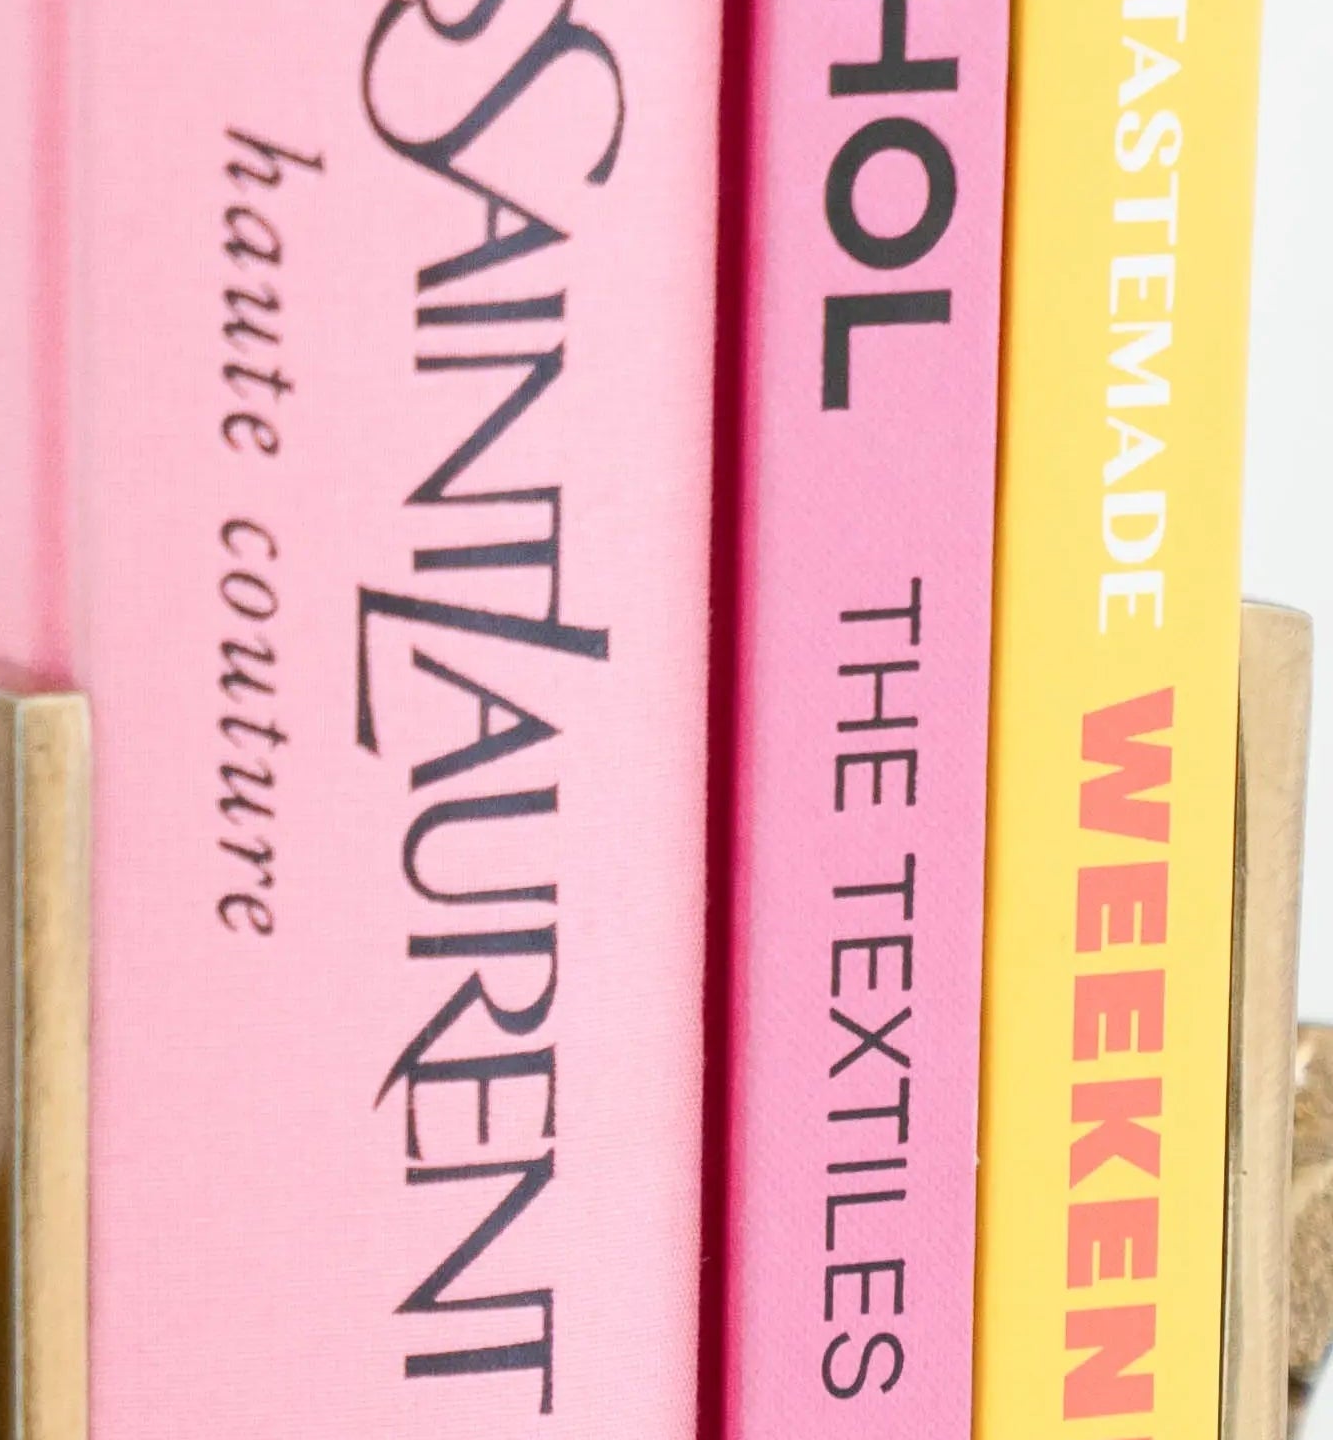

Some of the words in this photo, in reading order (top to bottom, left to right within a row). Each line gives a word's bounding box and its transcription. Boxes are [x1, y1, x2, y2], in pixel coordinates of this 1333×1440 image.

[221, 128, 323, 456] haute
[216, 518, 289, 936] couture
[834, 576, 922, 813] THE
[821, 852, 917, 1401] TEXTILES
